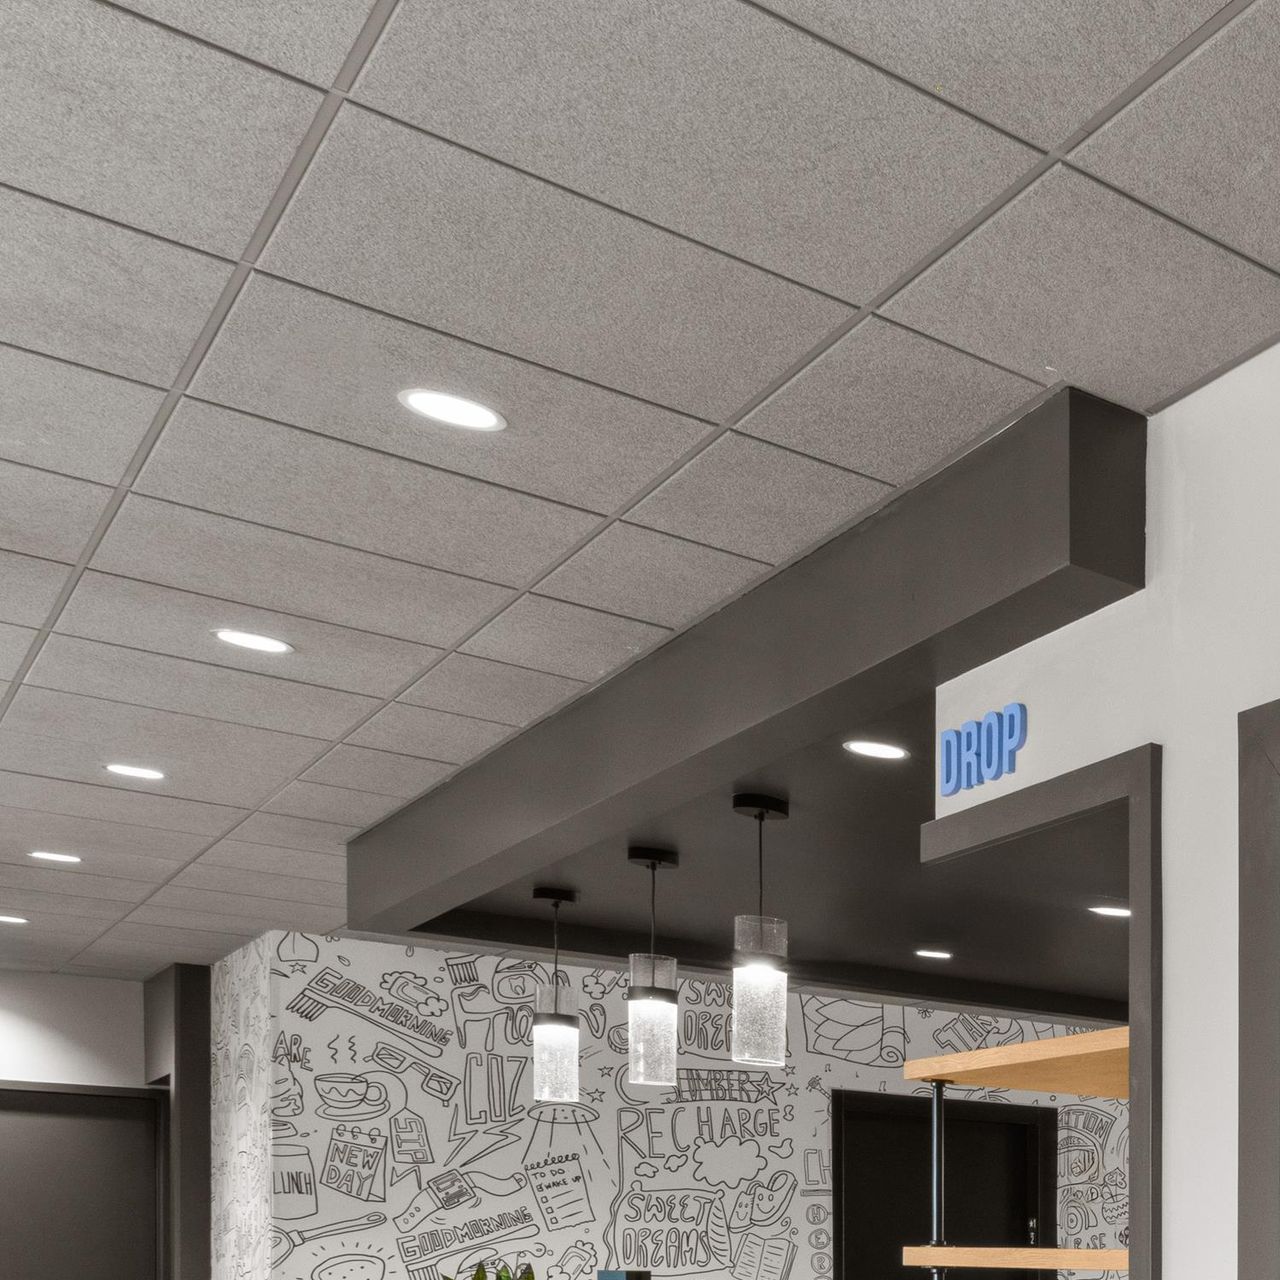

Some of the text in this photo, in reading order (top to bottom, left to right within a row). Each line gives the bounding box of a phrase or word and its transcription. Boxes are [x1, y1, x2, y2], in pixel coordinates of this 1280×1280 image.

[940, 702, 1028, 797] DROP
[685, 978, 734, 1009] SWE
[684, 1009, 734, 1053] DREA
[463, 1052, 541, 1126] COZ
[330, 1142, 379, 1171] NEW
[325, 1164, 374, 1197] DAY
[532, 1167, 565, 1180] TO DO
[543, 1174, 582, 1191] WAKE UP
[624, 1193, 713, 1226] SWEET
[622, 1226, 711, 1269] DREAMS
